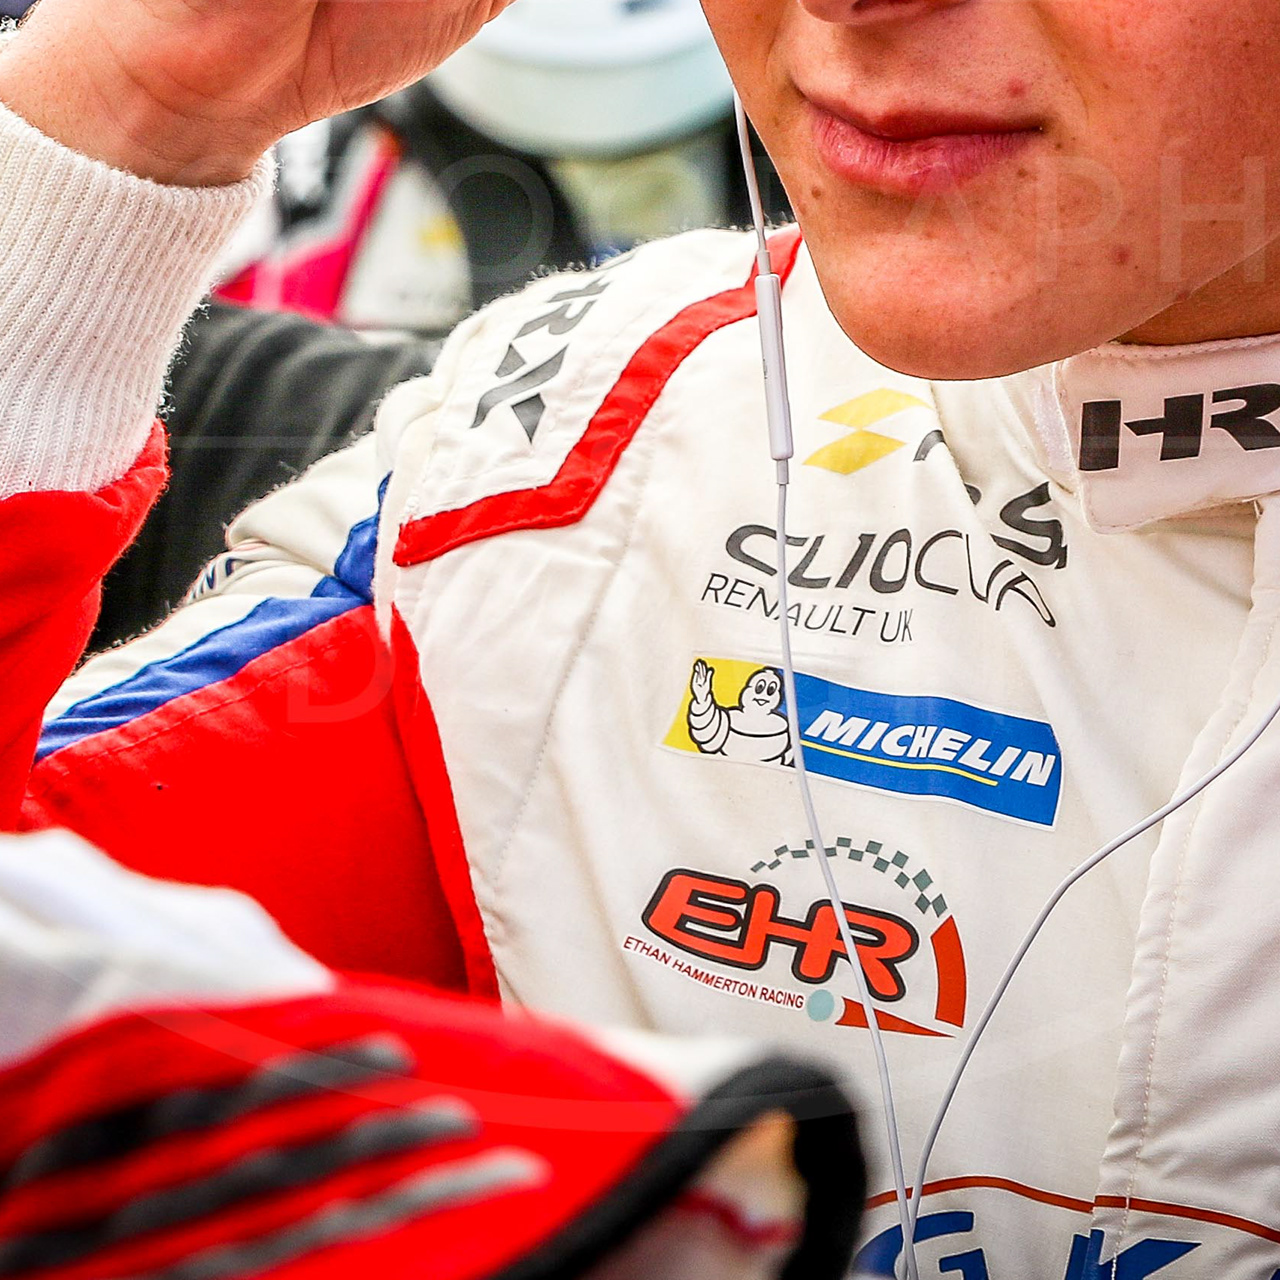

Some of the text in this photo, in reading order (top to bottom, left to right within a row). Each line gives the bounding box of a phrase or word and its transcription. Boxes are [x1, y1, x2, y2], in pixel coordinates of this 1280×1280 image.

[701, 572, 914, 643] RENAULT UK
[804, 709, 1057, 787] MICHELIN
[623, 936, 805, 1010] ETHAN HAMMERTON RACING
[641, 867, 919, 1003] EHR
